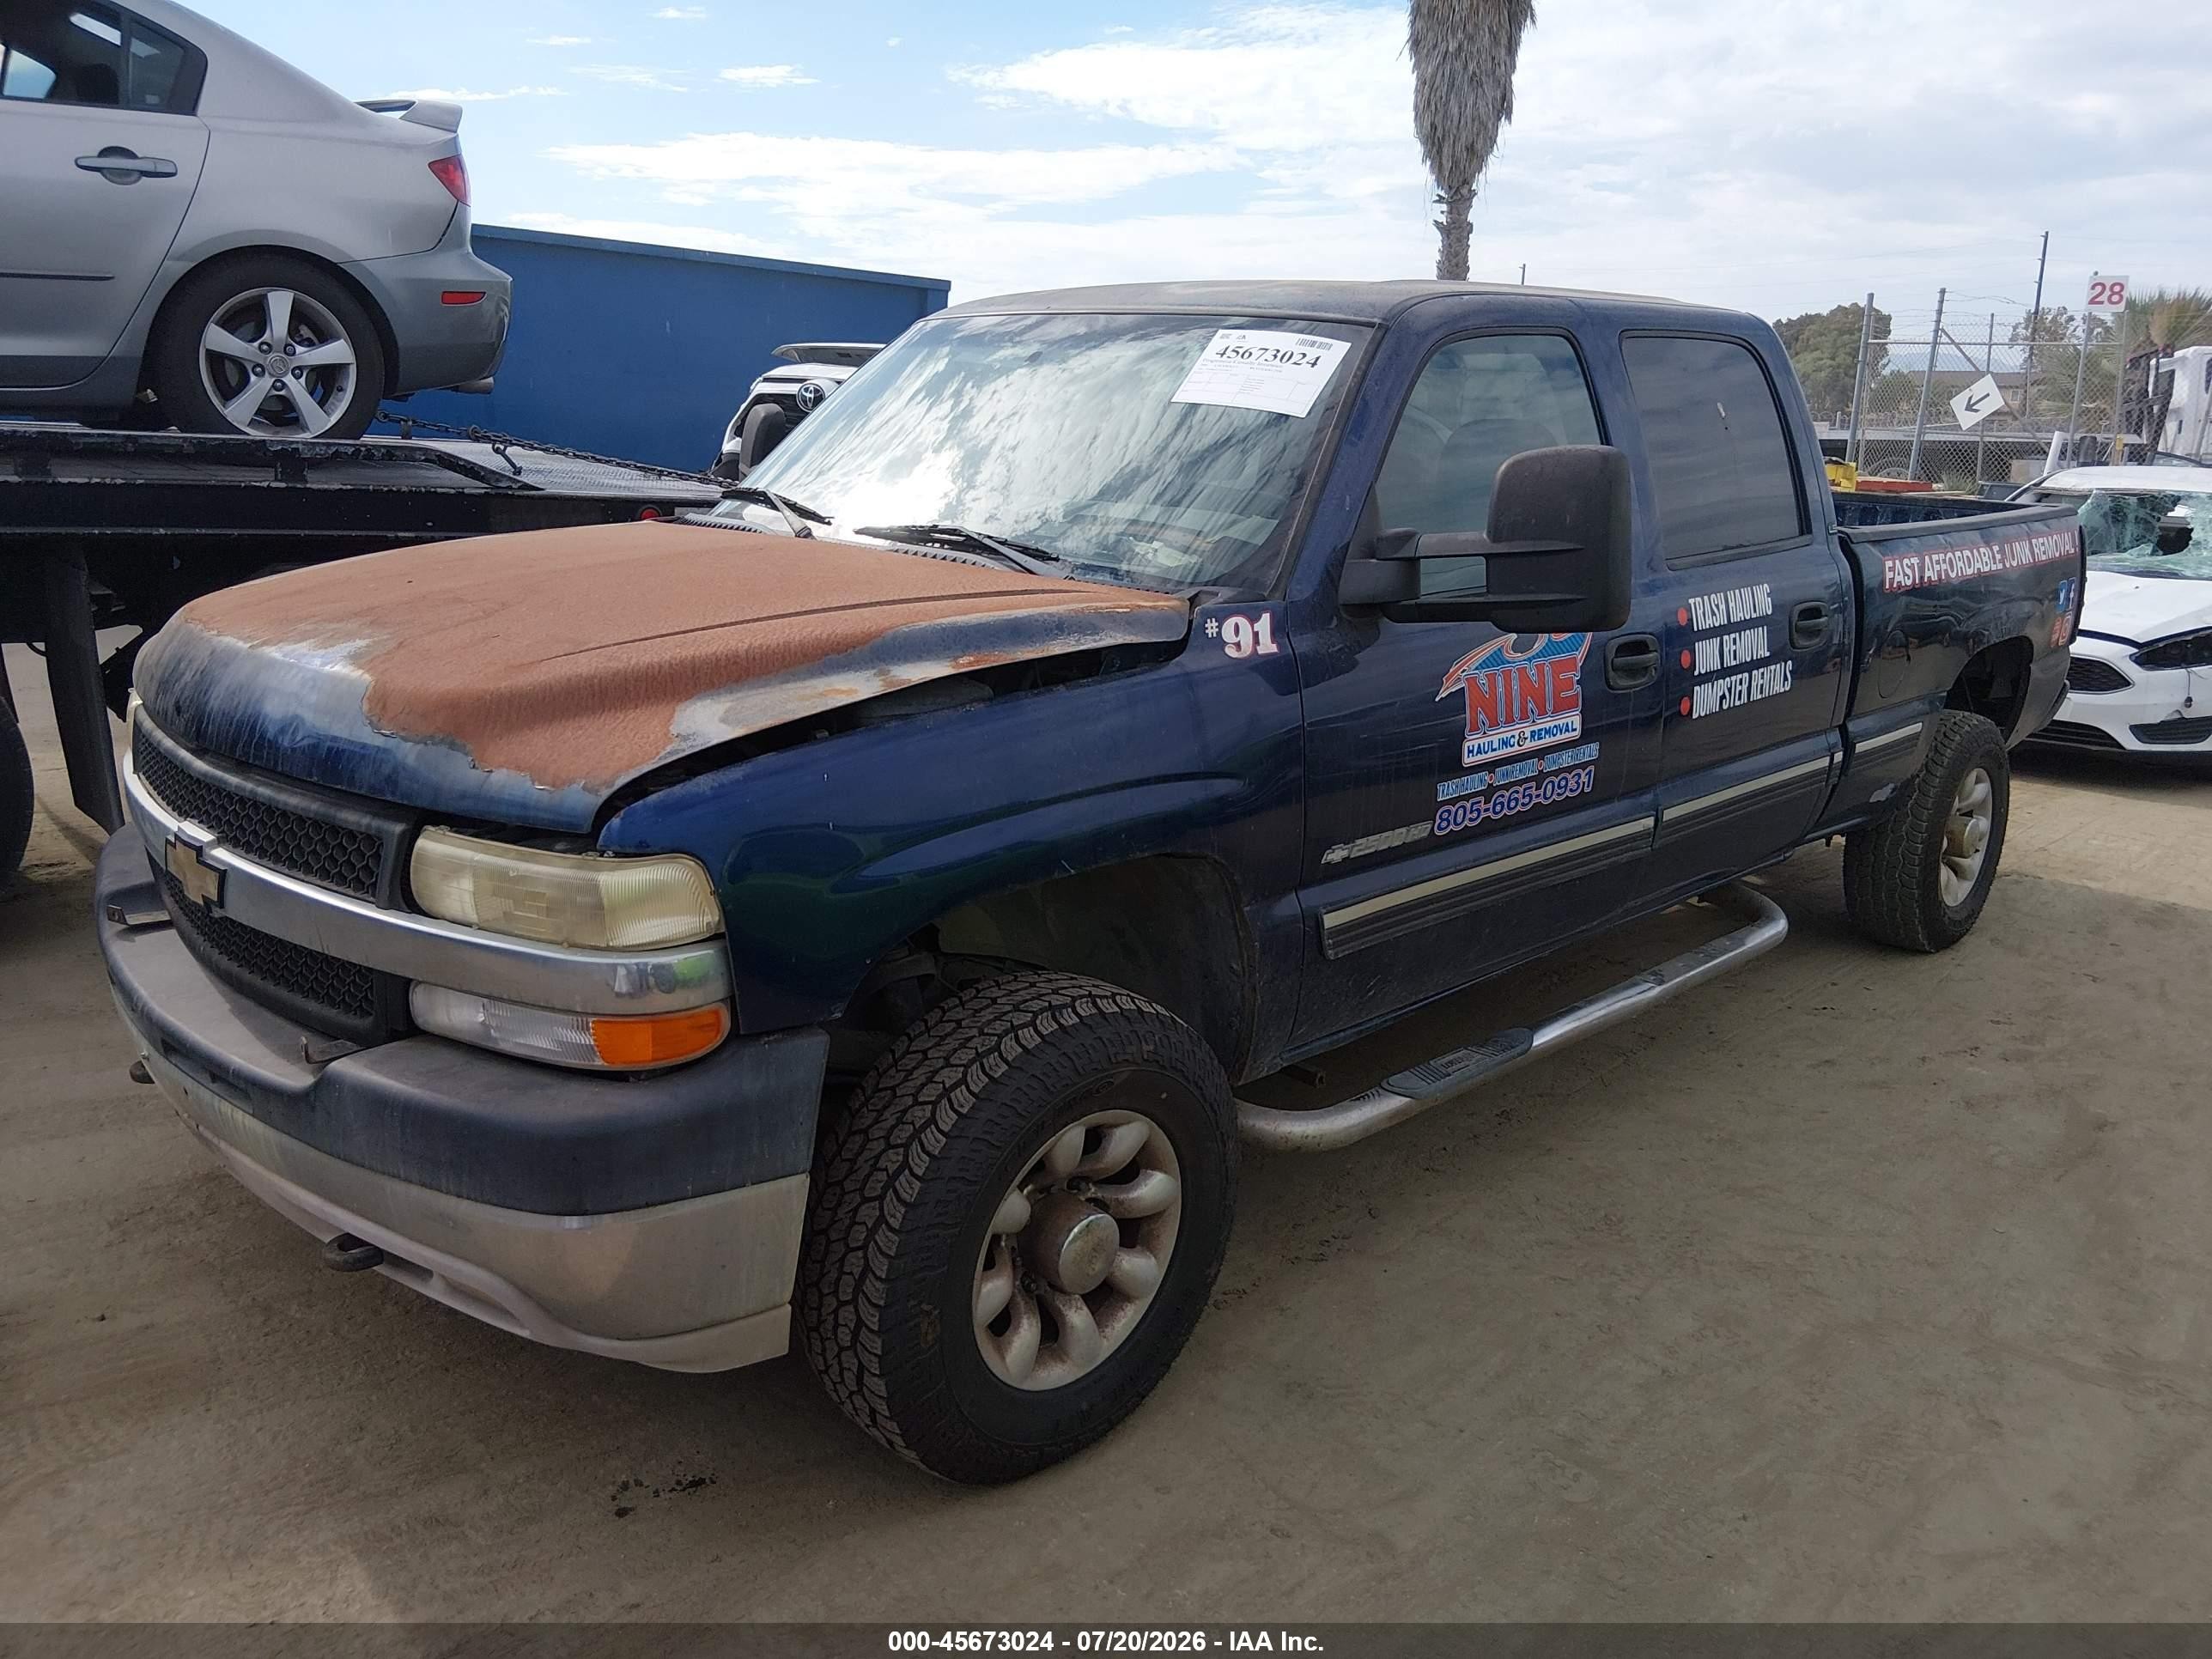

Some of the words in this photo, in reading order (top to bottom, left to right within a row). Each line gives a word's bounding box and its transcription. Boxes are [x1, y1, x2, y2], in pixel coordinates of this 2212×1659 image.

[2087, 282, 2125, 306] 28
[1216, 344, 1322, 368] 45673024
[1884, 556, 1920, 589] FAST
[1923, 544, 2002, 583] AFFORDABLE
[2004, 540, 2033, 568] JUNK
[1688, 592, 1728, 632] TRASH
[1727, 583, 1772, 623] HAULING
[1205, 612, 1279, 658] #91
[1693, 636, 1722, 677] JUNK
[1723, 625, 1771, 668] REMOVAL
[1464, 654, 1581, 736] NINE
[1692, 672, 1749, 720] DUMPSTER
[1750, 659, 1793, 702] RENTALS
[1467, 734, 1516, 759] HAULING
[1516, 730, 1528, 747] &
[1529, 720, 1577, 744] REMOVAL
[1434, 765, 1595, 836] 805-665-0931
[1437, 777, 1460, 802] TRASH
[1460, 770, 1489, 795] HAULING
[1511, 758, 1539, 782] REMOVAL
